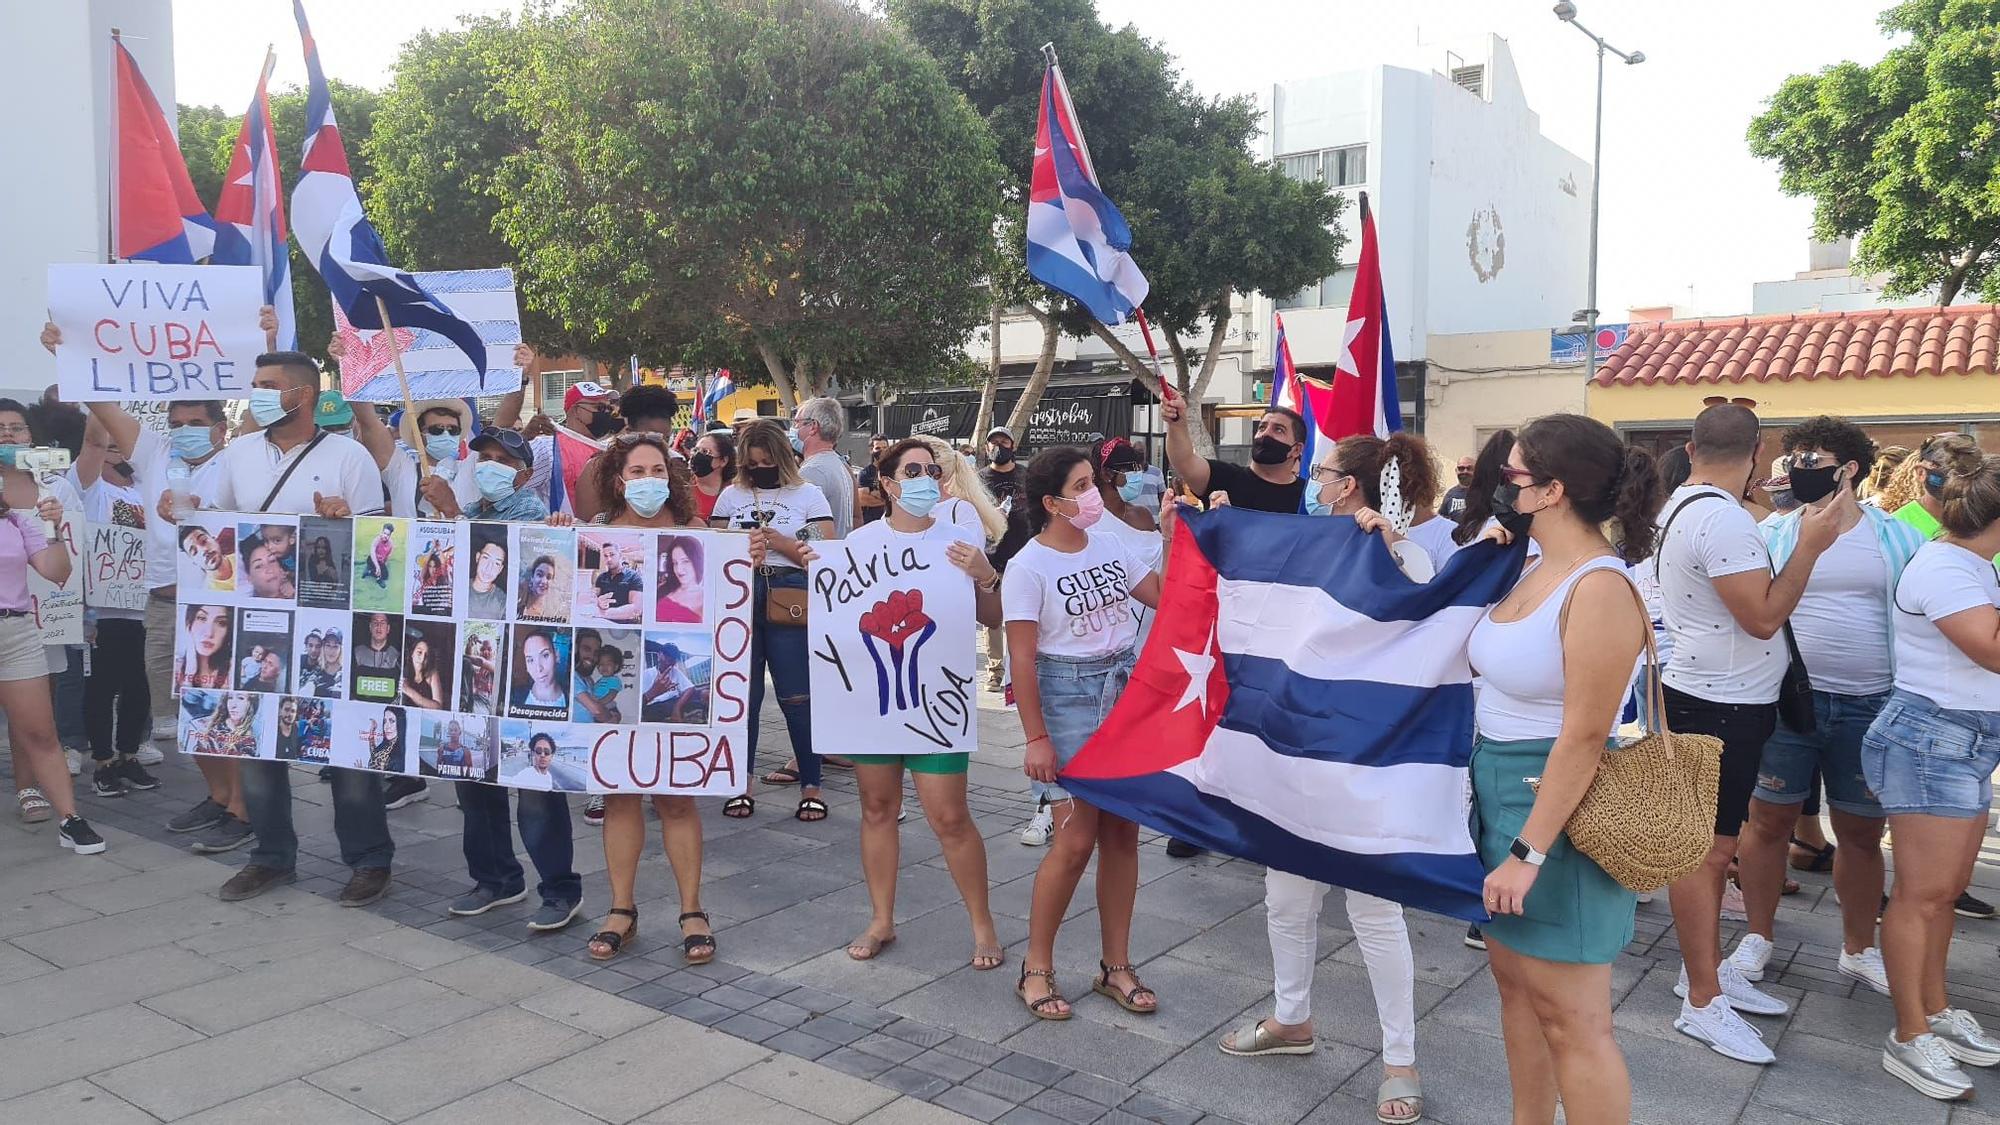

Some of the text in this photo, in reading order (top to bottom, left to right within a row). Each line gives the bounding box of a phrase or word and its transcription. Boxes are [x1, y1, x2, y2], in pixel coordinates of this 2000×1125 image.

[102, 278, 209, 312] VIVA
[93, 318, 225, 360] CUBA
[90, 357, 243, 394] LIBRE
[814, 545, 931, 612] Patria
[1056, 560, 1127, 596] GUESS
[516, 613, 567, 624] Desaparecida
[714, 559, 752, 723] SOS
[814, 634, 853, 692] Y
[361, 679, 389, 692] FREE
[510, 706, 567, 718] Desaparecida
[307, 746, 331, 758] CUBA
[591, 730, 736, 789] CUBA
[437, 764, 461, 776] PATRIA
[462, 766, 467, 777] Y
